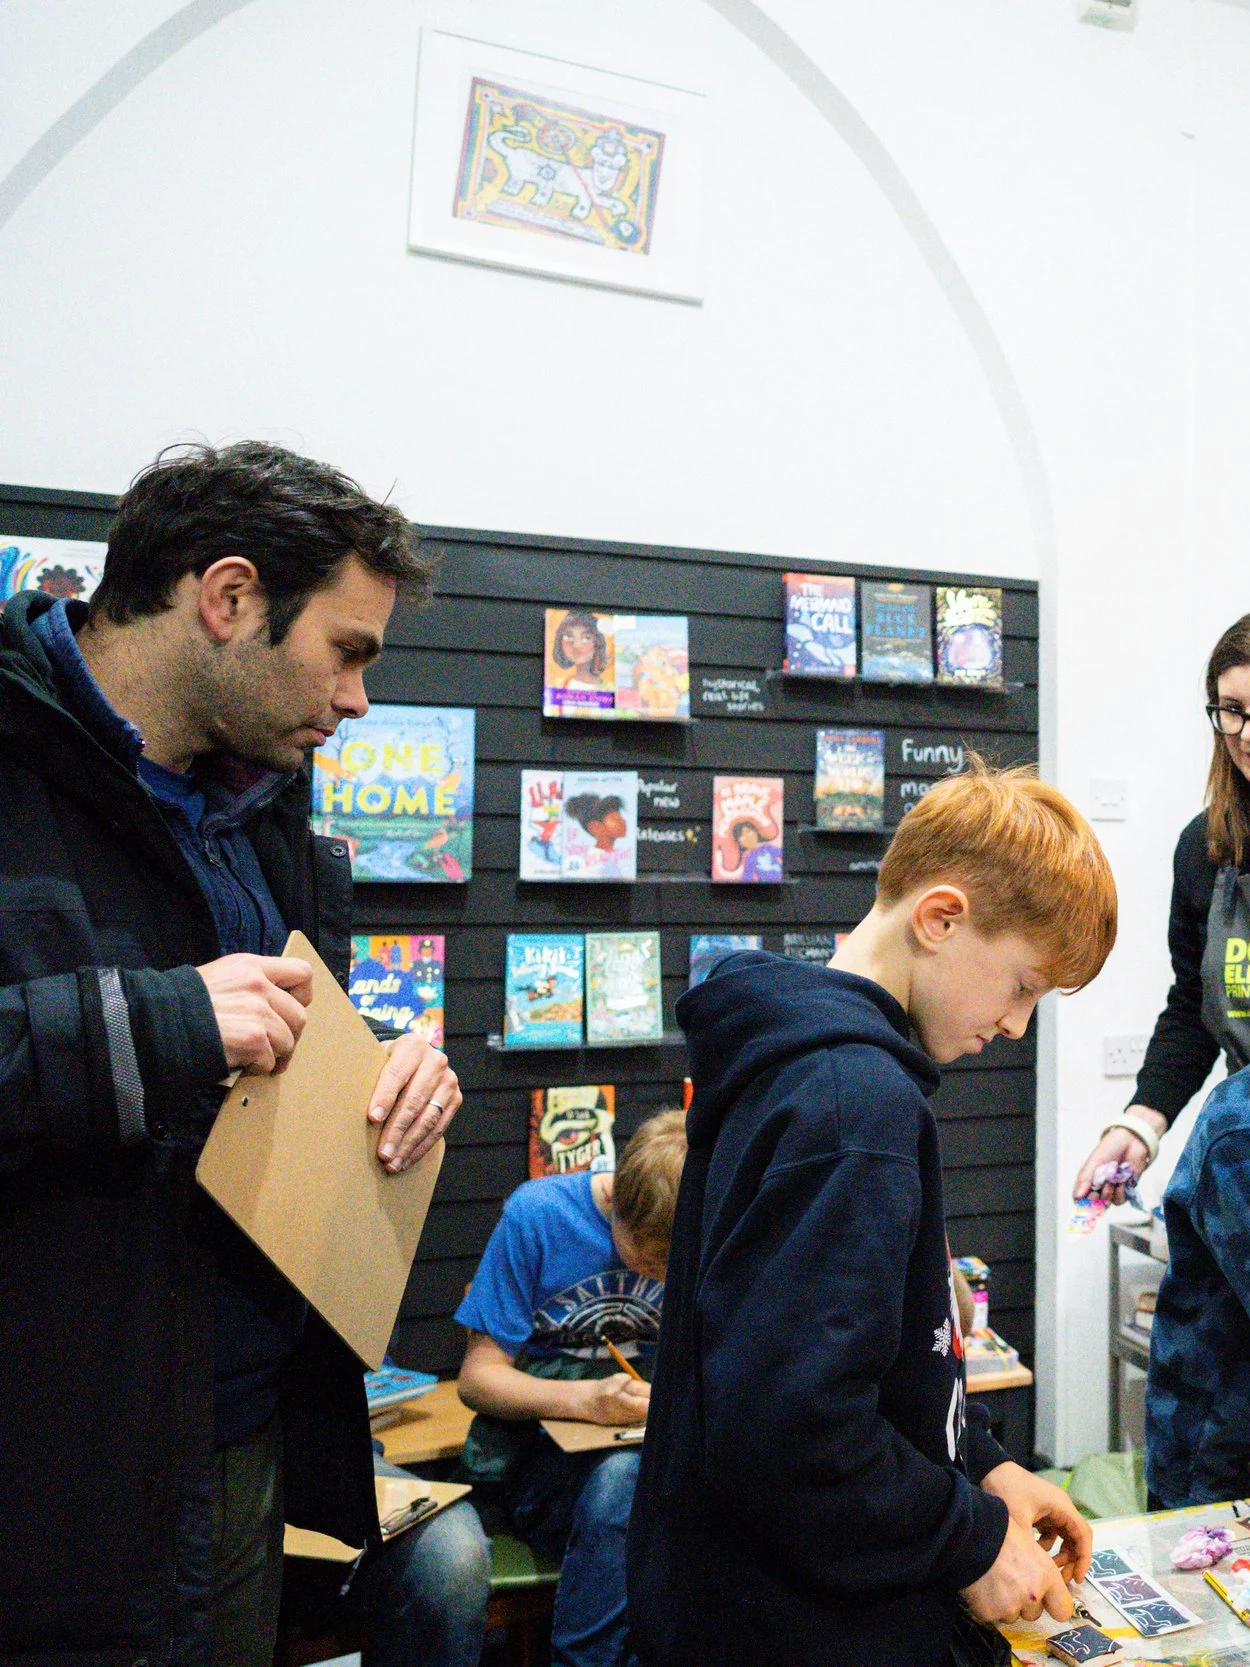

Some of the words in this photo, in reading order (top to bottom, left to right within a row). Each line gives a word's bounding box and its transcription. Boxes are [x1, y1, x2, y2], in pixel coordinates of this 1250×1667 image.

[800, 583, 824, 597] THE
[811, 613, 853, 635] CALL
[340, 741, 443, 774] ONE
[901, 738, 964, 774] Funny
[322, 783, 457, 816] HOME
[653, 796, 681, 809] new
[349, 972, 402, 996] ands
[557, 1138, 601, 1174] TYGER
